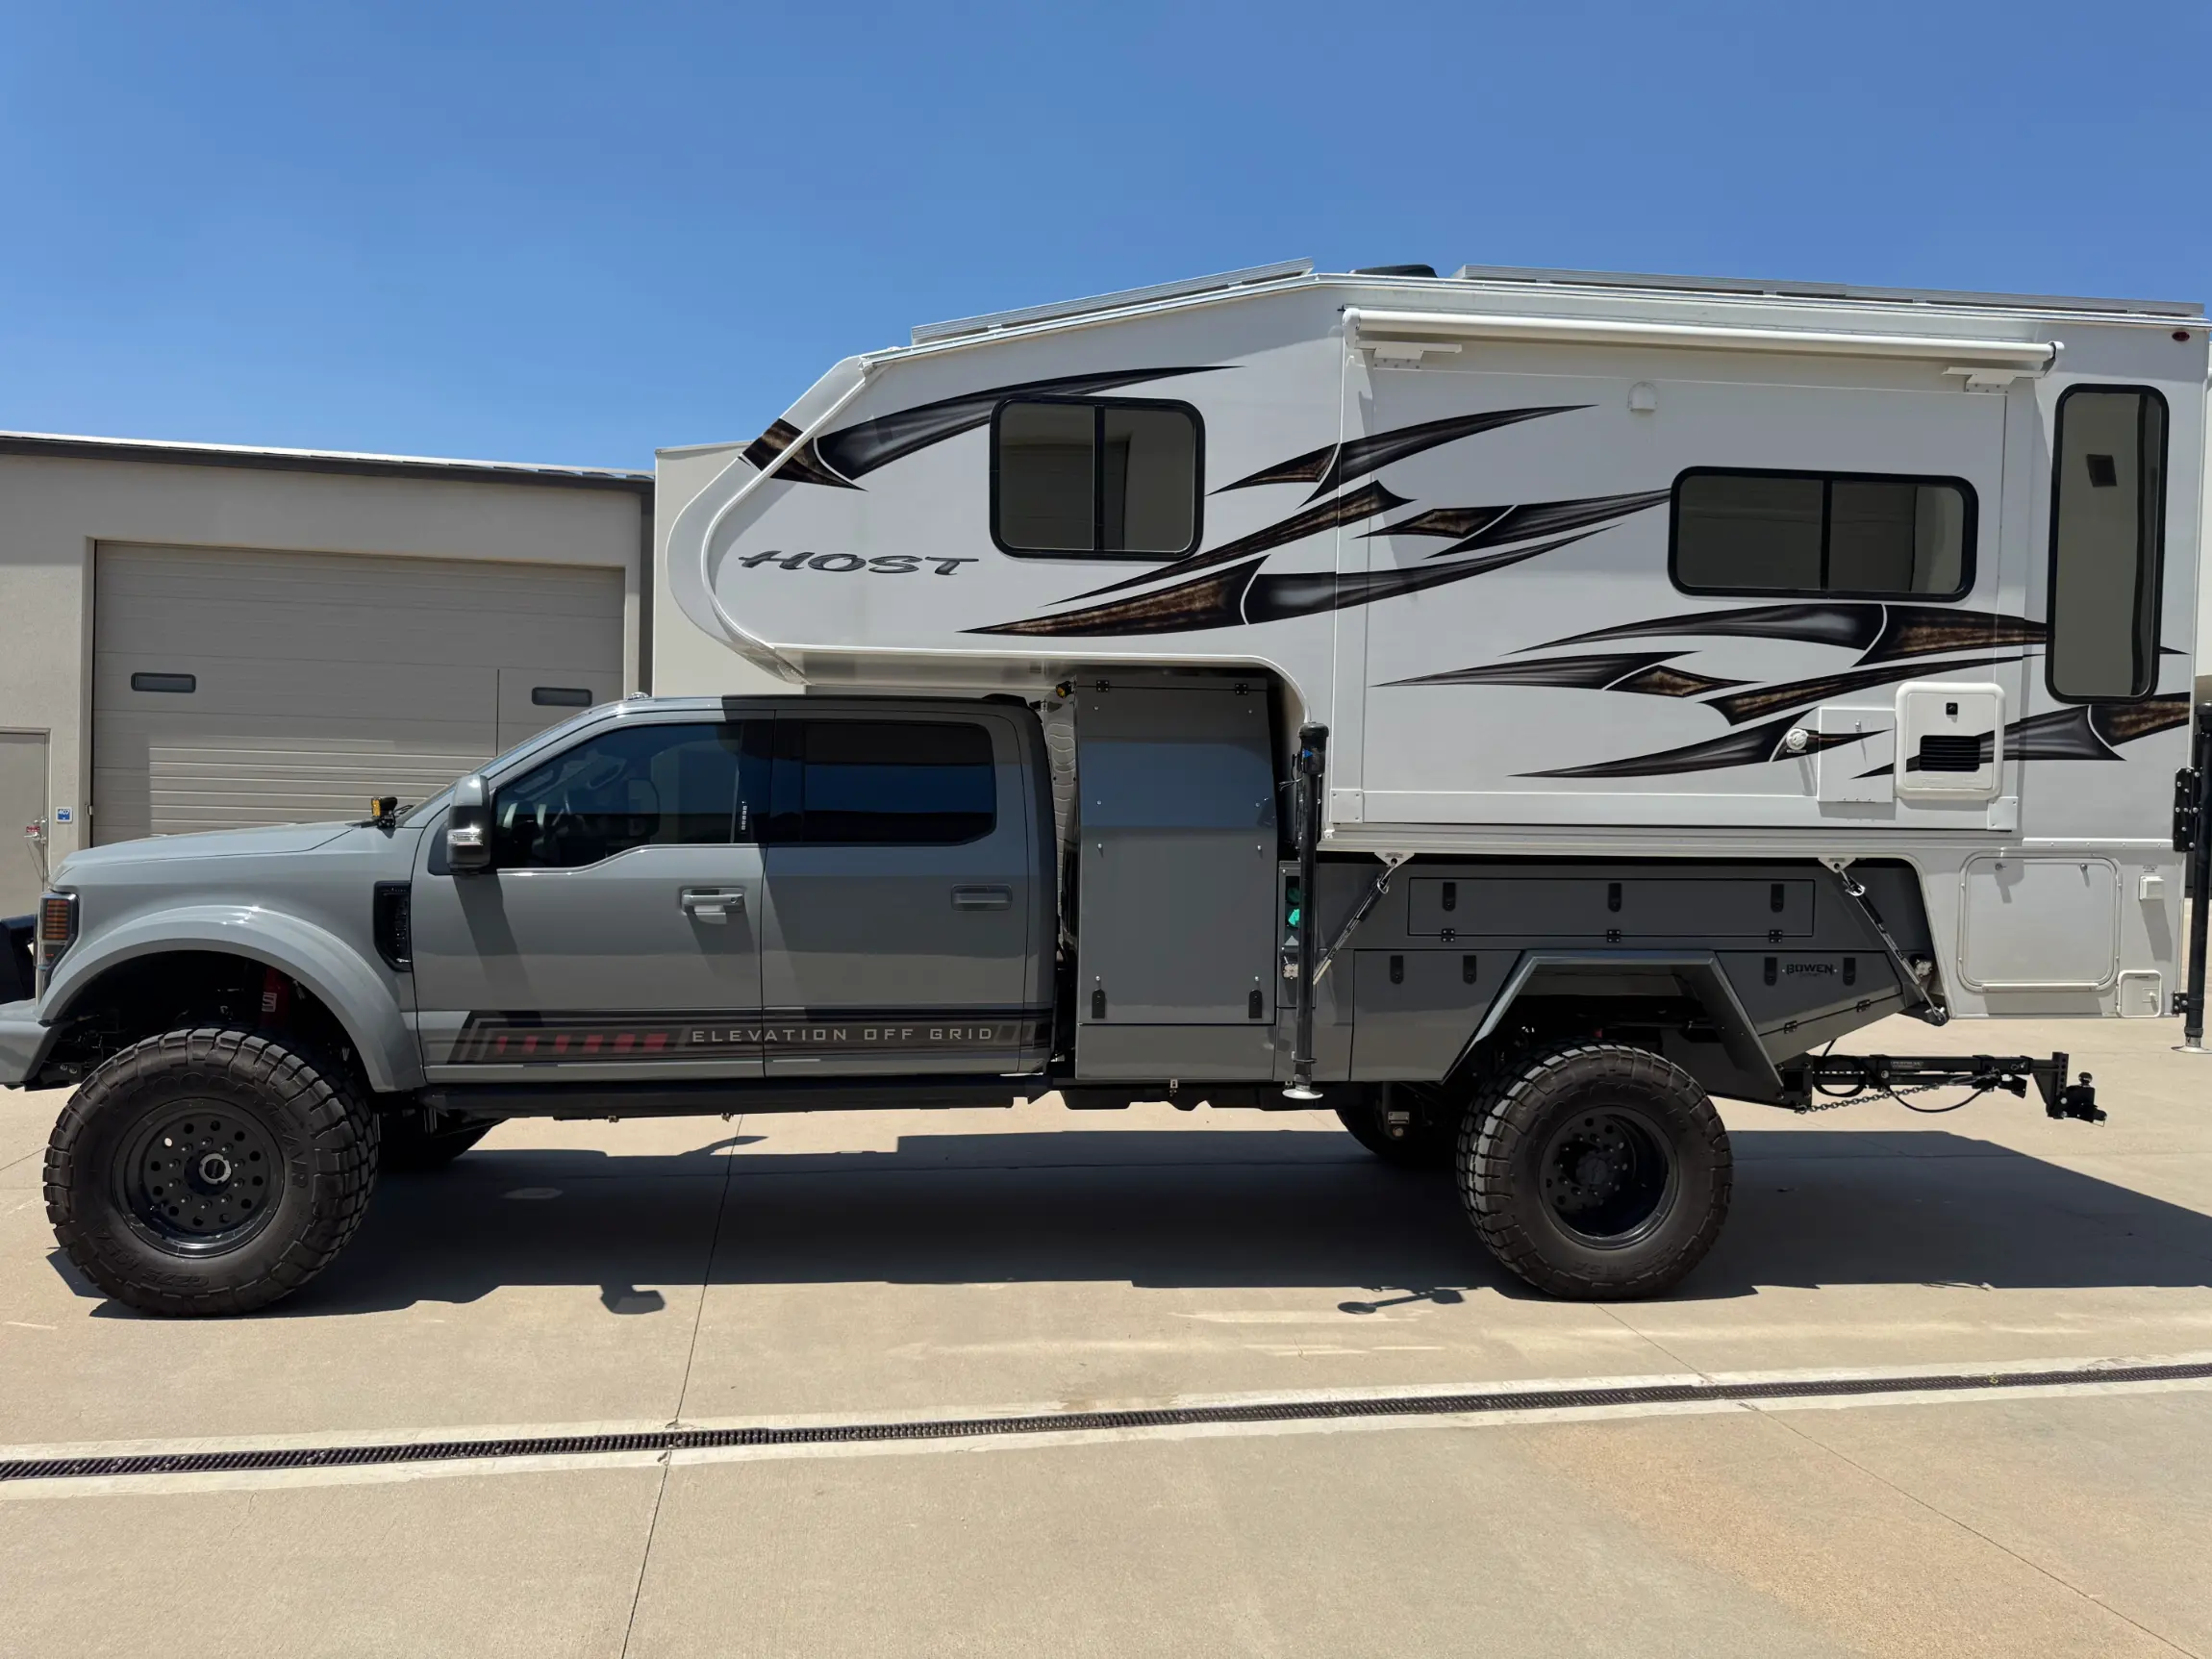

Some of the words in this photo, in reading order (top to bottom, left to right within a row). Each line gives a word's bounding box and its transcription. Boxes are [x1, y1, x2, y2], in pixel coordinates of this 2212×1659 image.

[739, 550, 979, 575] HOST
[1786, 964, 1833, 975] BOWEN
[692, 1029, 846, 1043] ELEVATION
[864, 1028, 914, 1041] OFF
[929, 1028, 992, 1040] GRID
